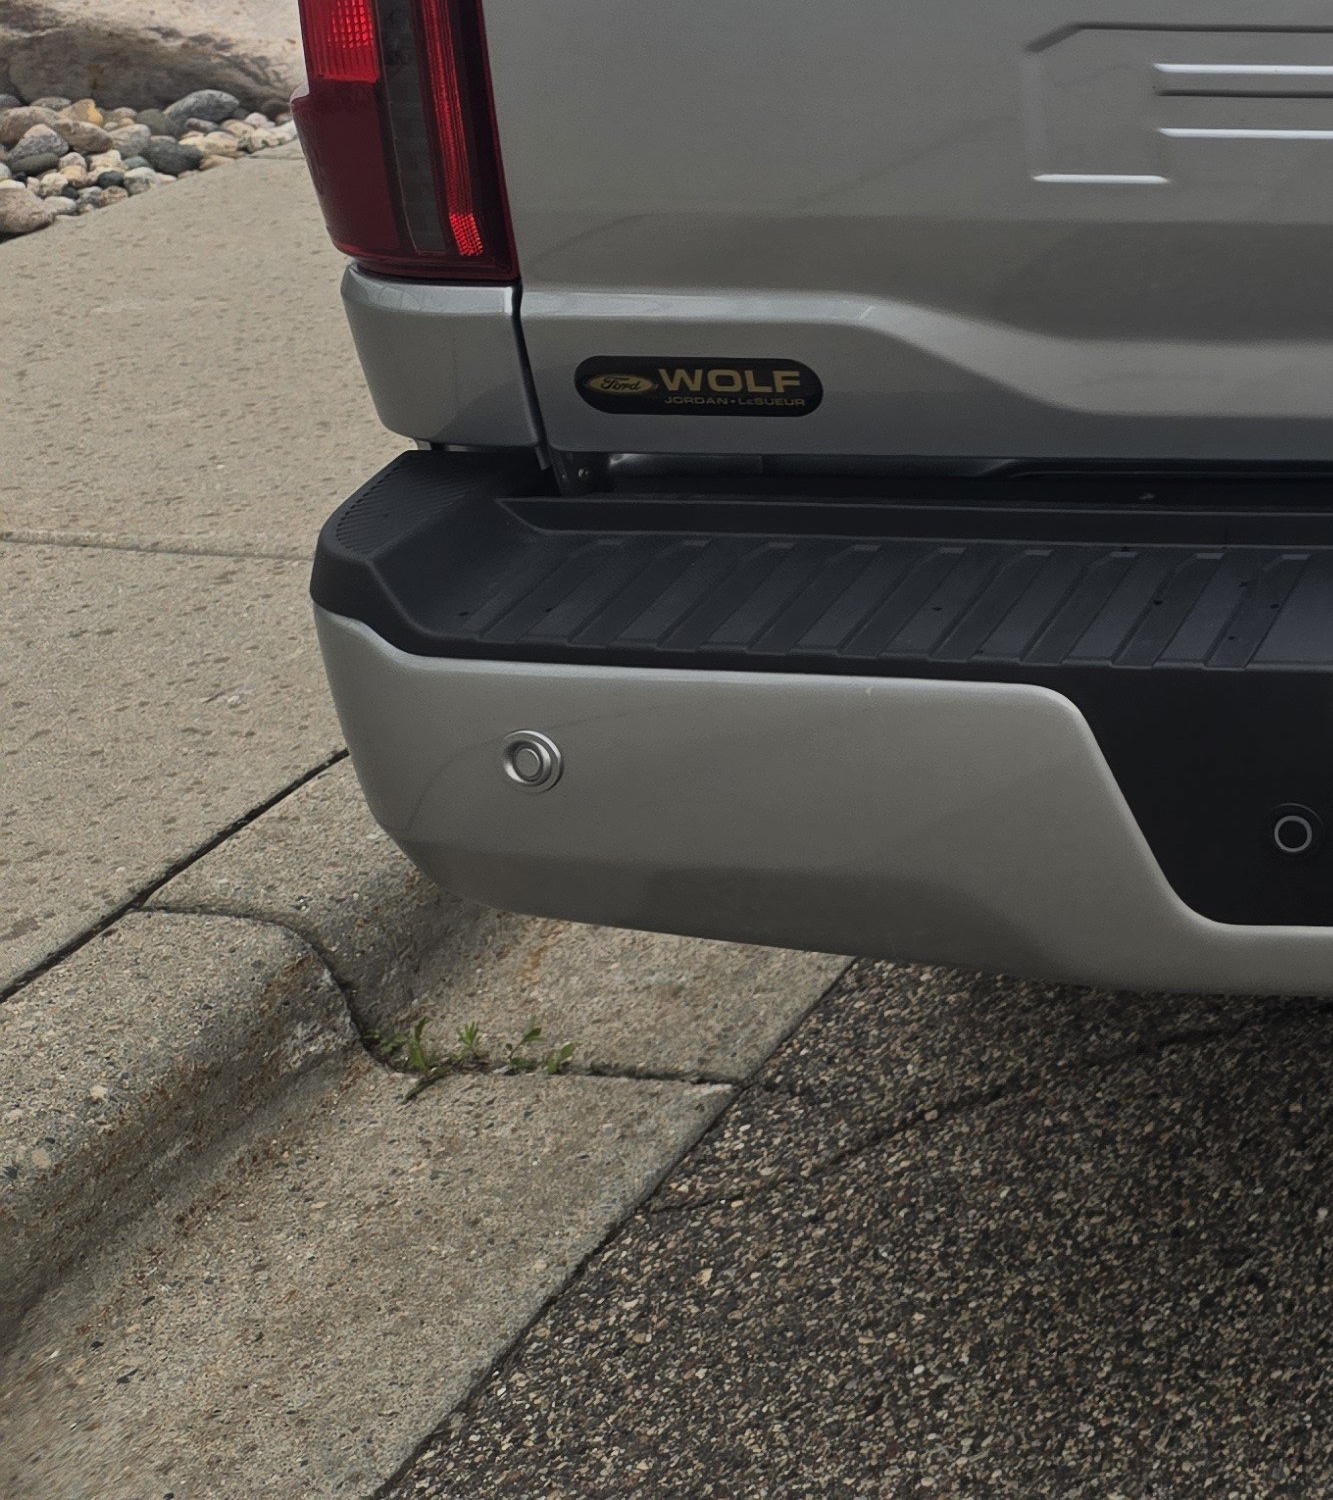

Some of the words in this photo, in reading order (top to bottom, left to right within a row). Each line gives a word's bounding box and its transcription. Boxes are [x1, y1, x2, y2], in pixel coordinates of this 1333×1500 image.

[600, 376, 642, 391] Ford
[659, 368, 801, 393] WOLF
[664, 396, 728, 406] JORDAN
